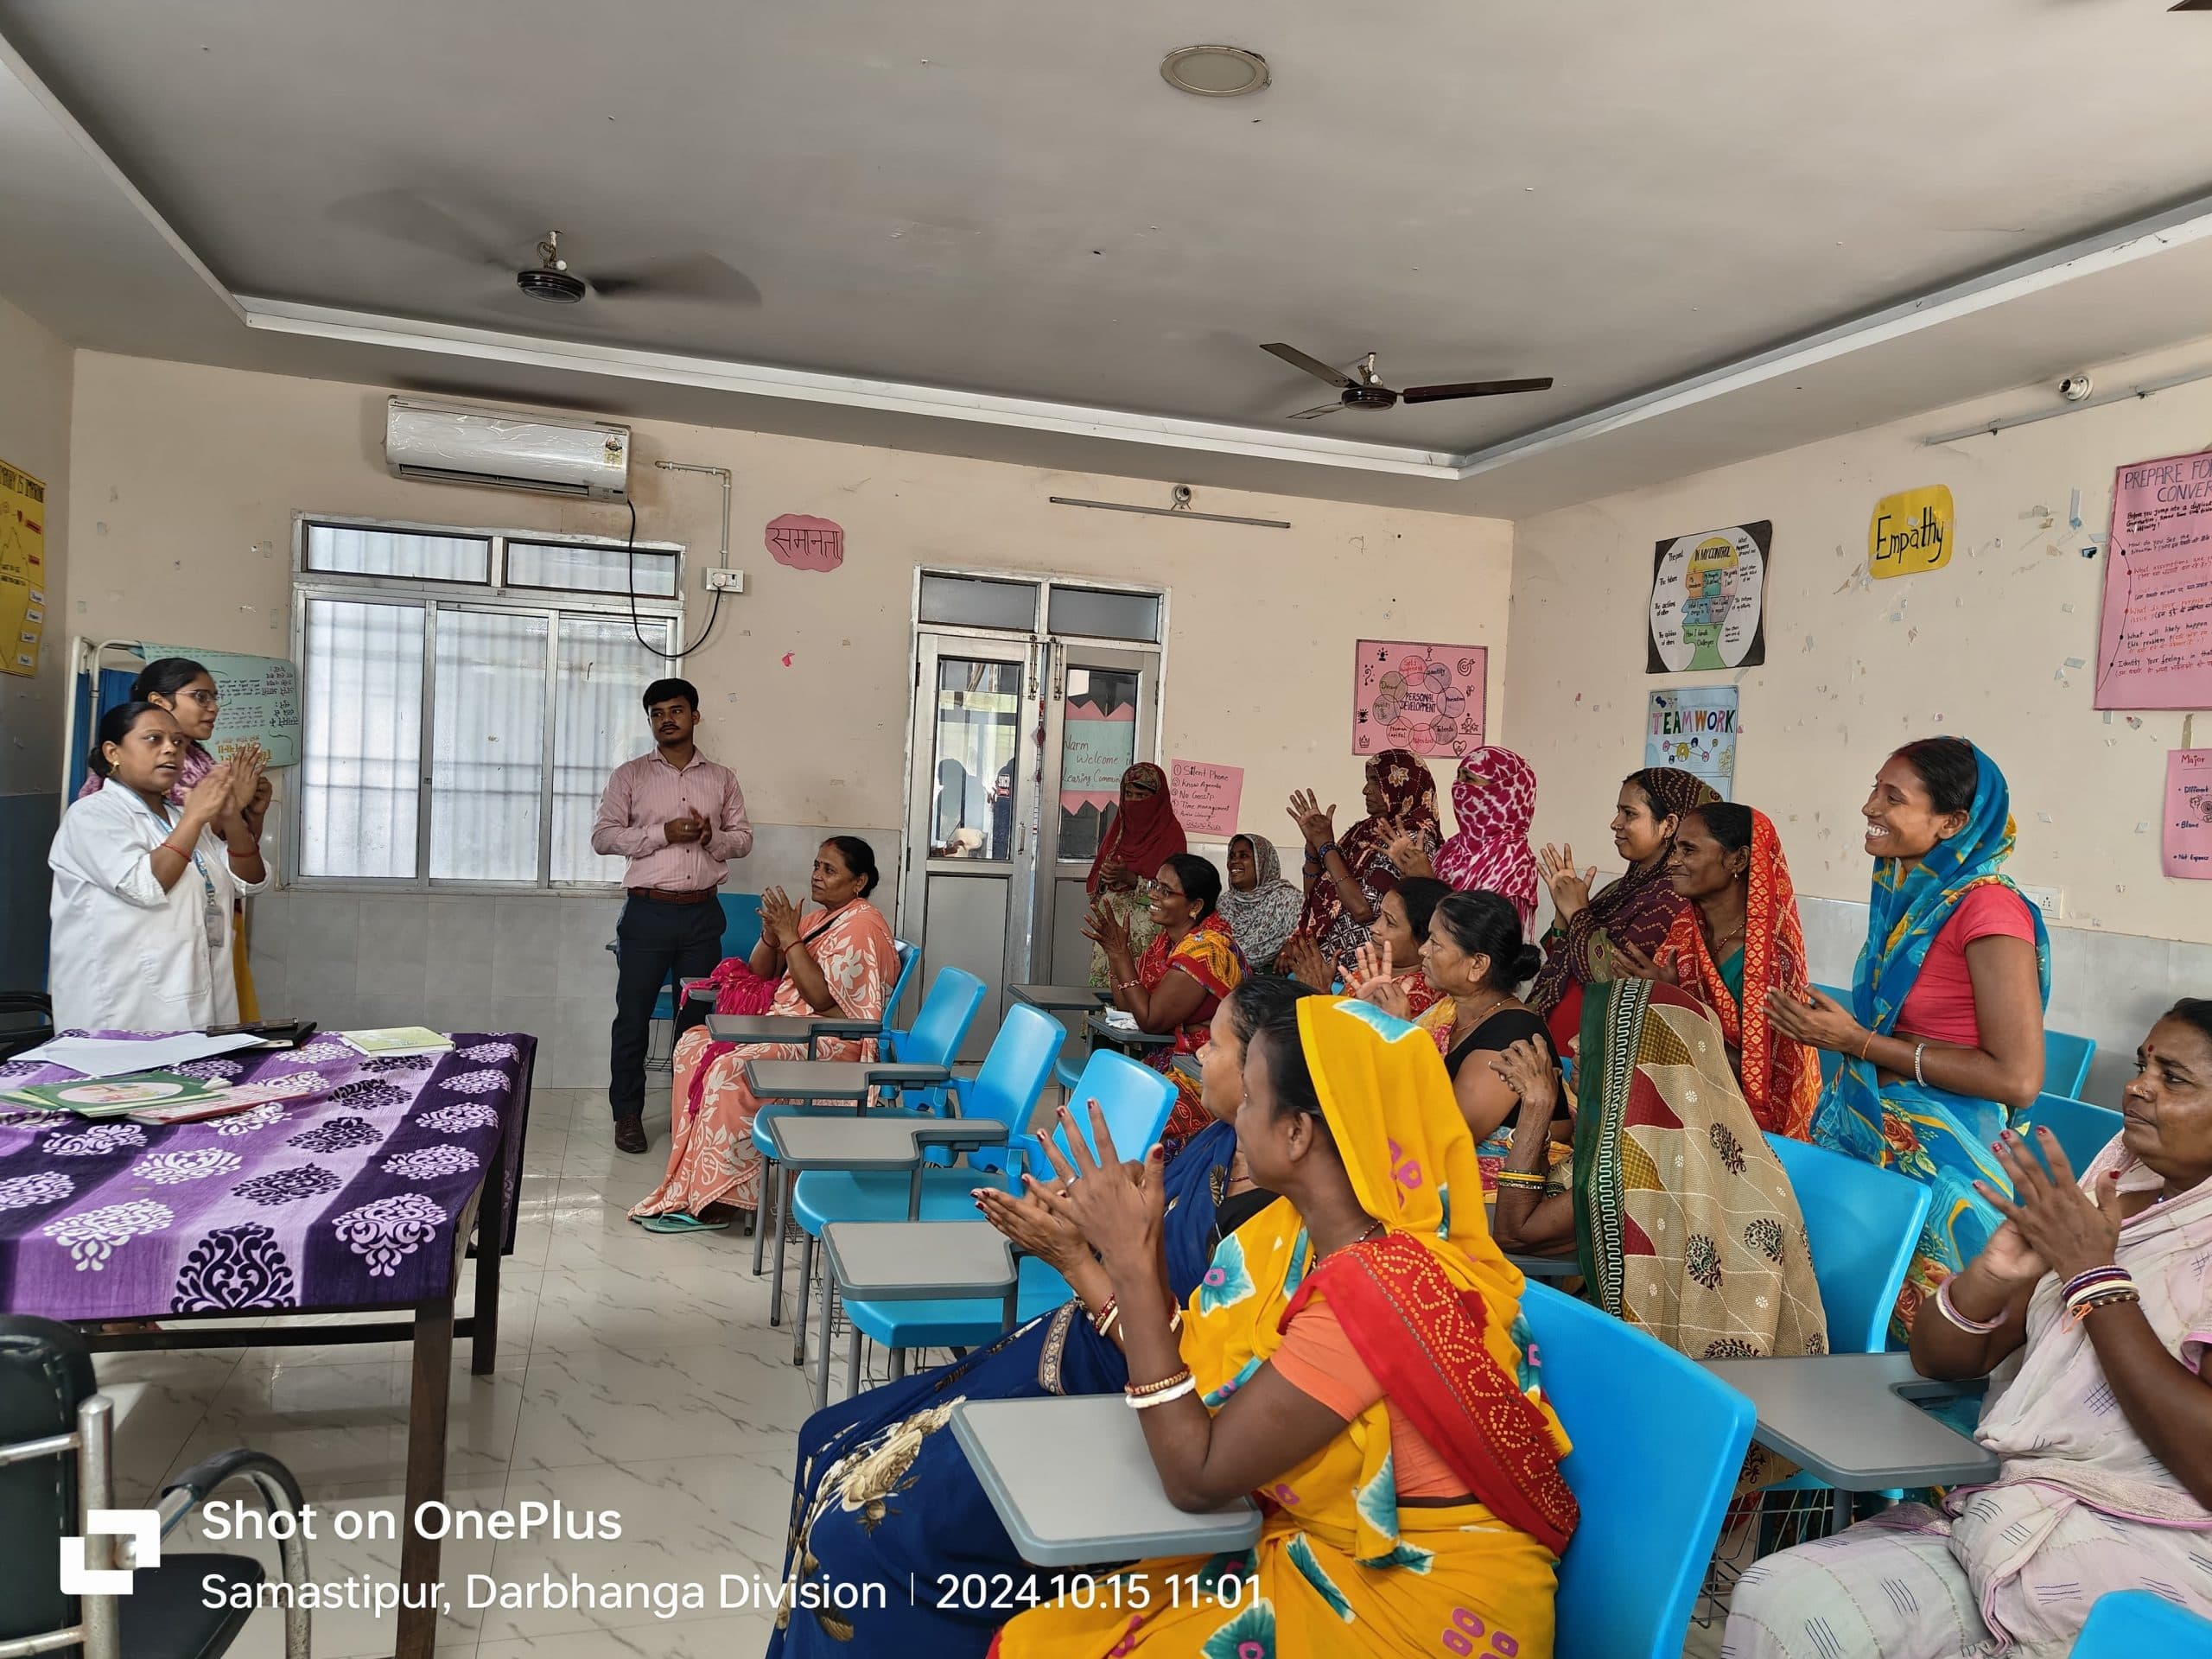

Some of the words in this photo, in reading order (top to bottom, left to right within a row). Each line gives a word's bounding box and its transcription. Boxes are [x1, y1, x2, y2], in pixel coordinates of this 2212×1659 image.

[2125, 463, 2183, 490] PREPARE
[1876, 505, 1944, 564] Empathy
[767, 527, 842, 561] समानता
[1708, 545, 1731, 560] CONTROL
[1405, 691, 1434, 702] PERSONAL
[1399, 700, 1436, 713] DEVELOPMENT
[1651, 709, 1736, 735] TEAMWORK
[1076, 751, 1119, 765] Welcome
[2181, 753, 2206, 766] Major
[1183, 765, 1206, 778] Silent
[1209, 769, 1229, 781] Phone
[1179, 790, 1189, 799] No
